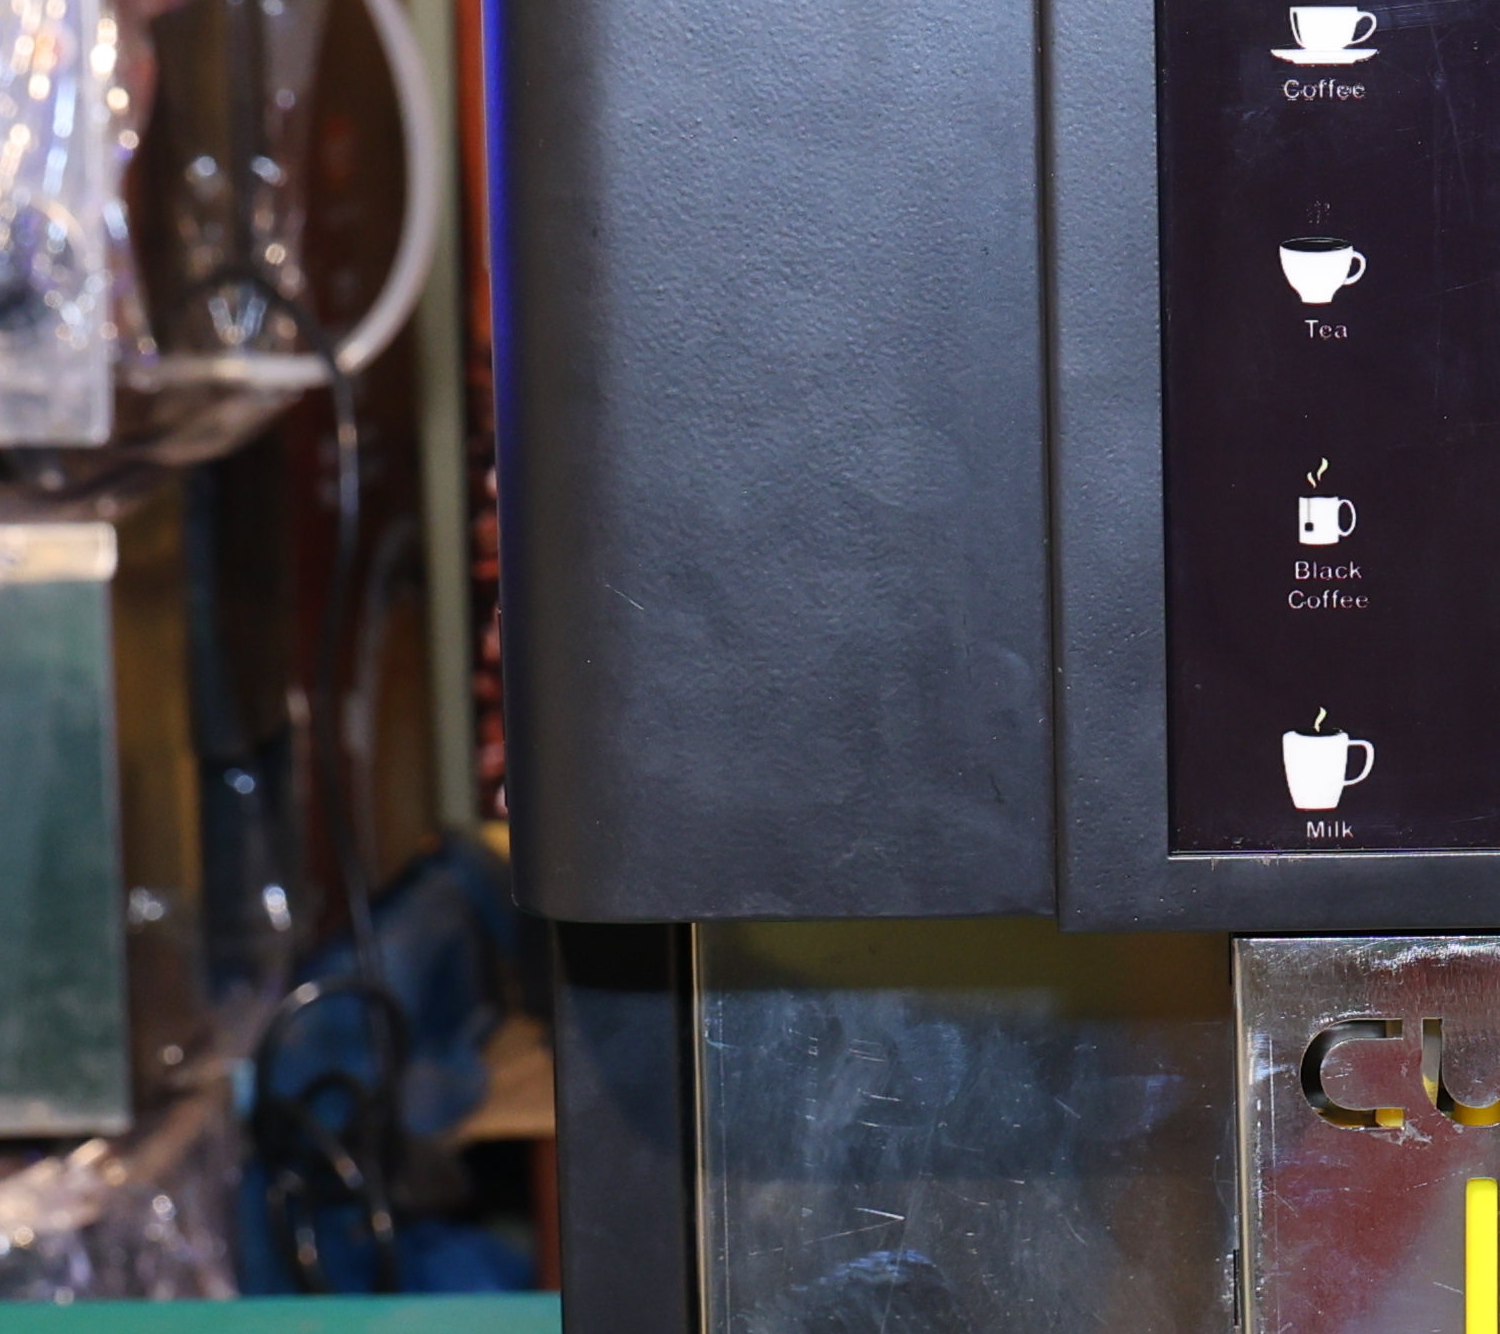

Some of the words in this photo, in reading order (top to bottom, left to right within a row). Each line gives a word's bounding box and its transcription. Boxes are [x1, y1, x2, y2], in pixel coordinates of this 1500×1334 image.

[1282, 78, 1366, 101] Coffee
[1304, 319, 1349, 339] Tea
[1295, 560, 1362, 580] Black
[1288, 589, 1369, 610] Coffee
[1306, 820, 1354, 839] Milk
